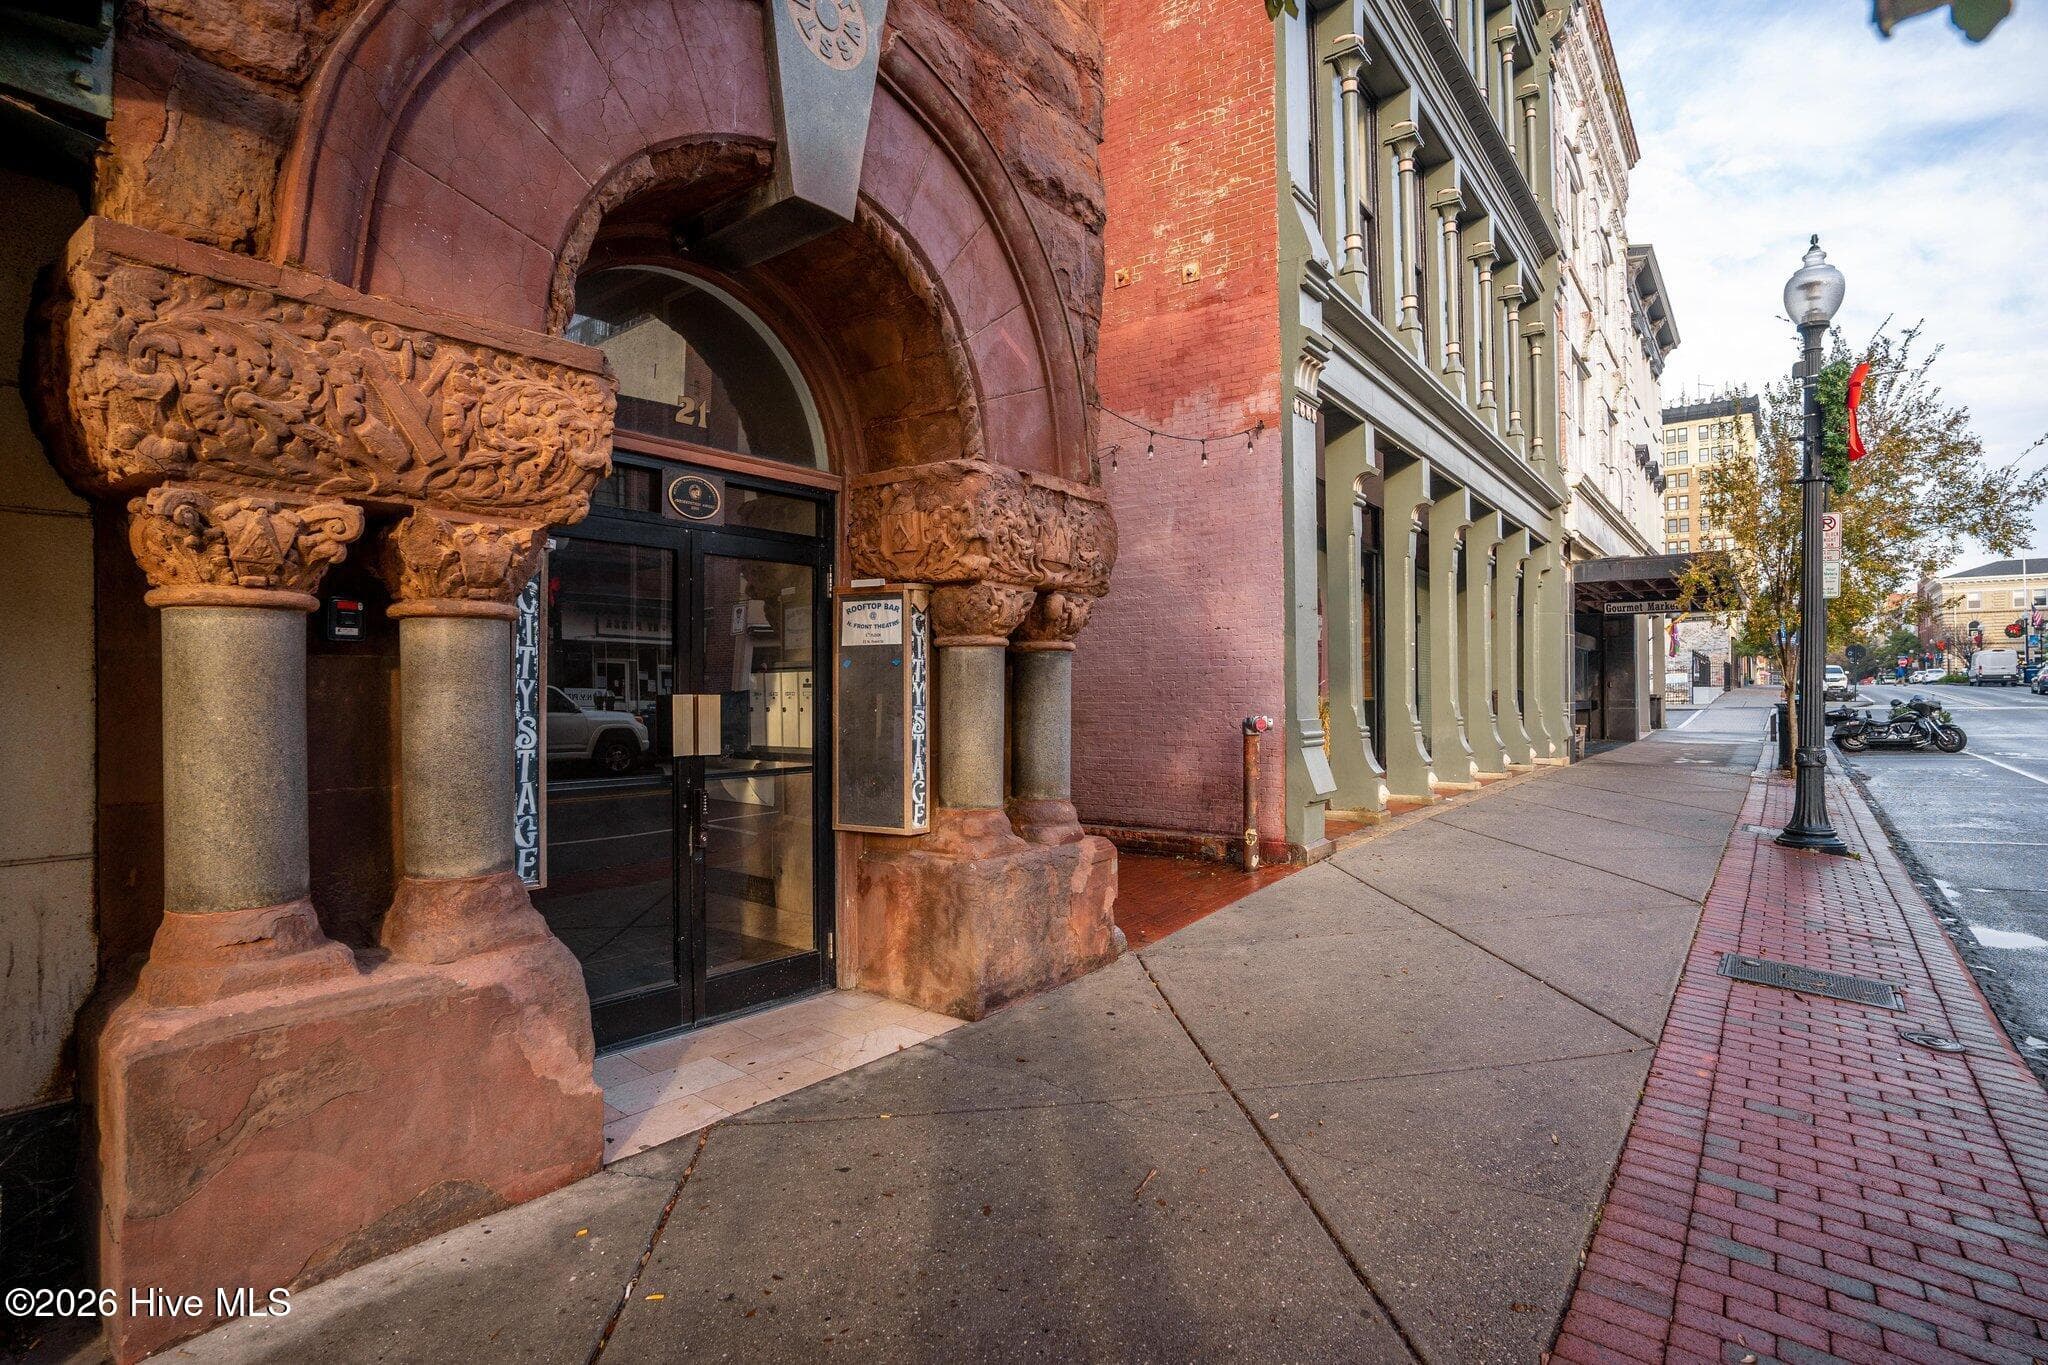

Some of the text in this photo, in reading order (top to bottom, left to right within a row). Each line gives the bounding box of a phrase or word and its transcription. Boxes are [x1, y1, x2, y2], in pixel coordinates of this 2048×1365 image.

[674, 396, 708, 429] 21
[846, 602, 900, 614] ROOFTOP BAR
[1605, 603, 1643, 613] Gourmet
[874, 618, 901, 630] THEATRE
